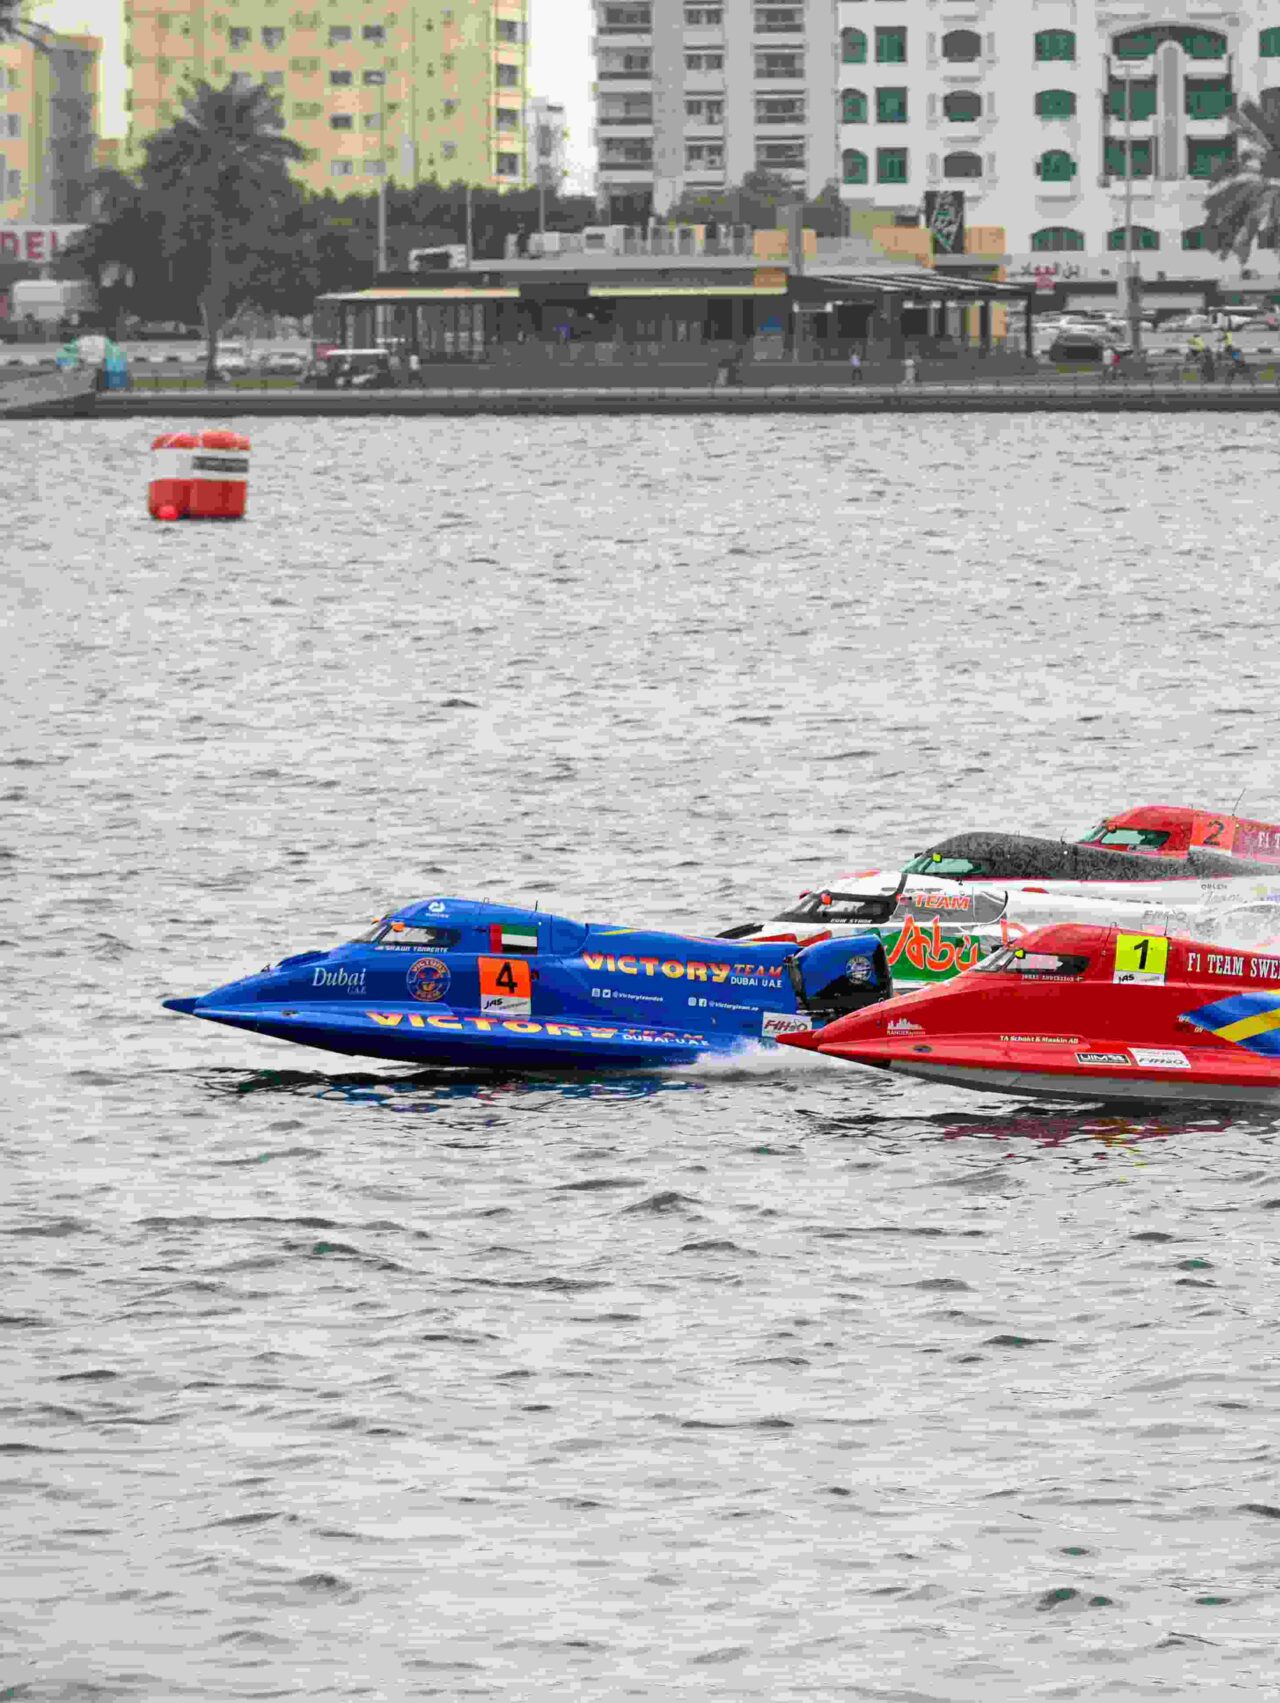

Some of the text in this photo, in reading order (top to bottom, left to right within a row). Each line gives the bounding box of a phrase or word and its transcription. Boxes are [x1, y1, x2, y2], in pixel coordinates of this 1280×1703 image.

[1203, 820, 1225, 846] 2
[1257, 832, 1270, 848] F1
[915, 895, 970, 911] TEAM
[582, 951, 784, 983] VICTORY TEAM
[1133, 939, 1149, 970] 1
[1187, 952, 1201, 973] F1
[1208, 953, 1244, 976] TEAM
[312, 967, 367, 987] Dubai
[496, 962, 518, 994] 4
[730, 976, 759, 987] DUBAI
[365, 1010, 618, 1039] VICTORY
